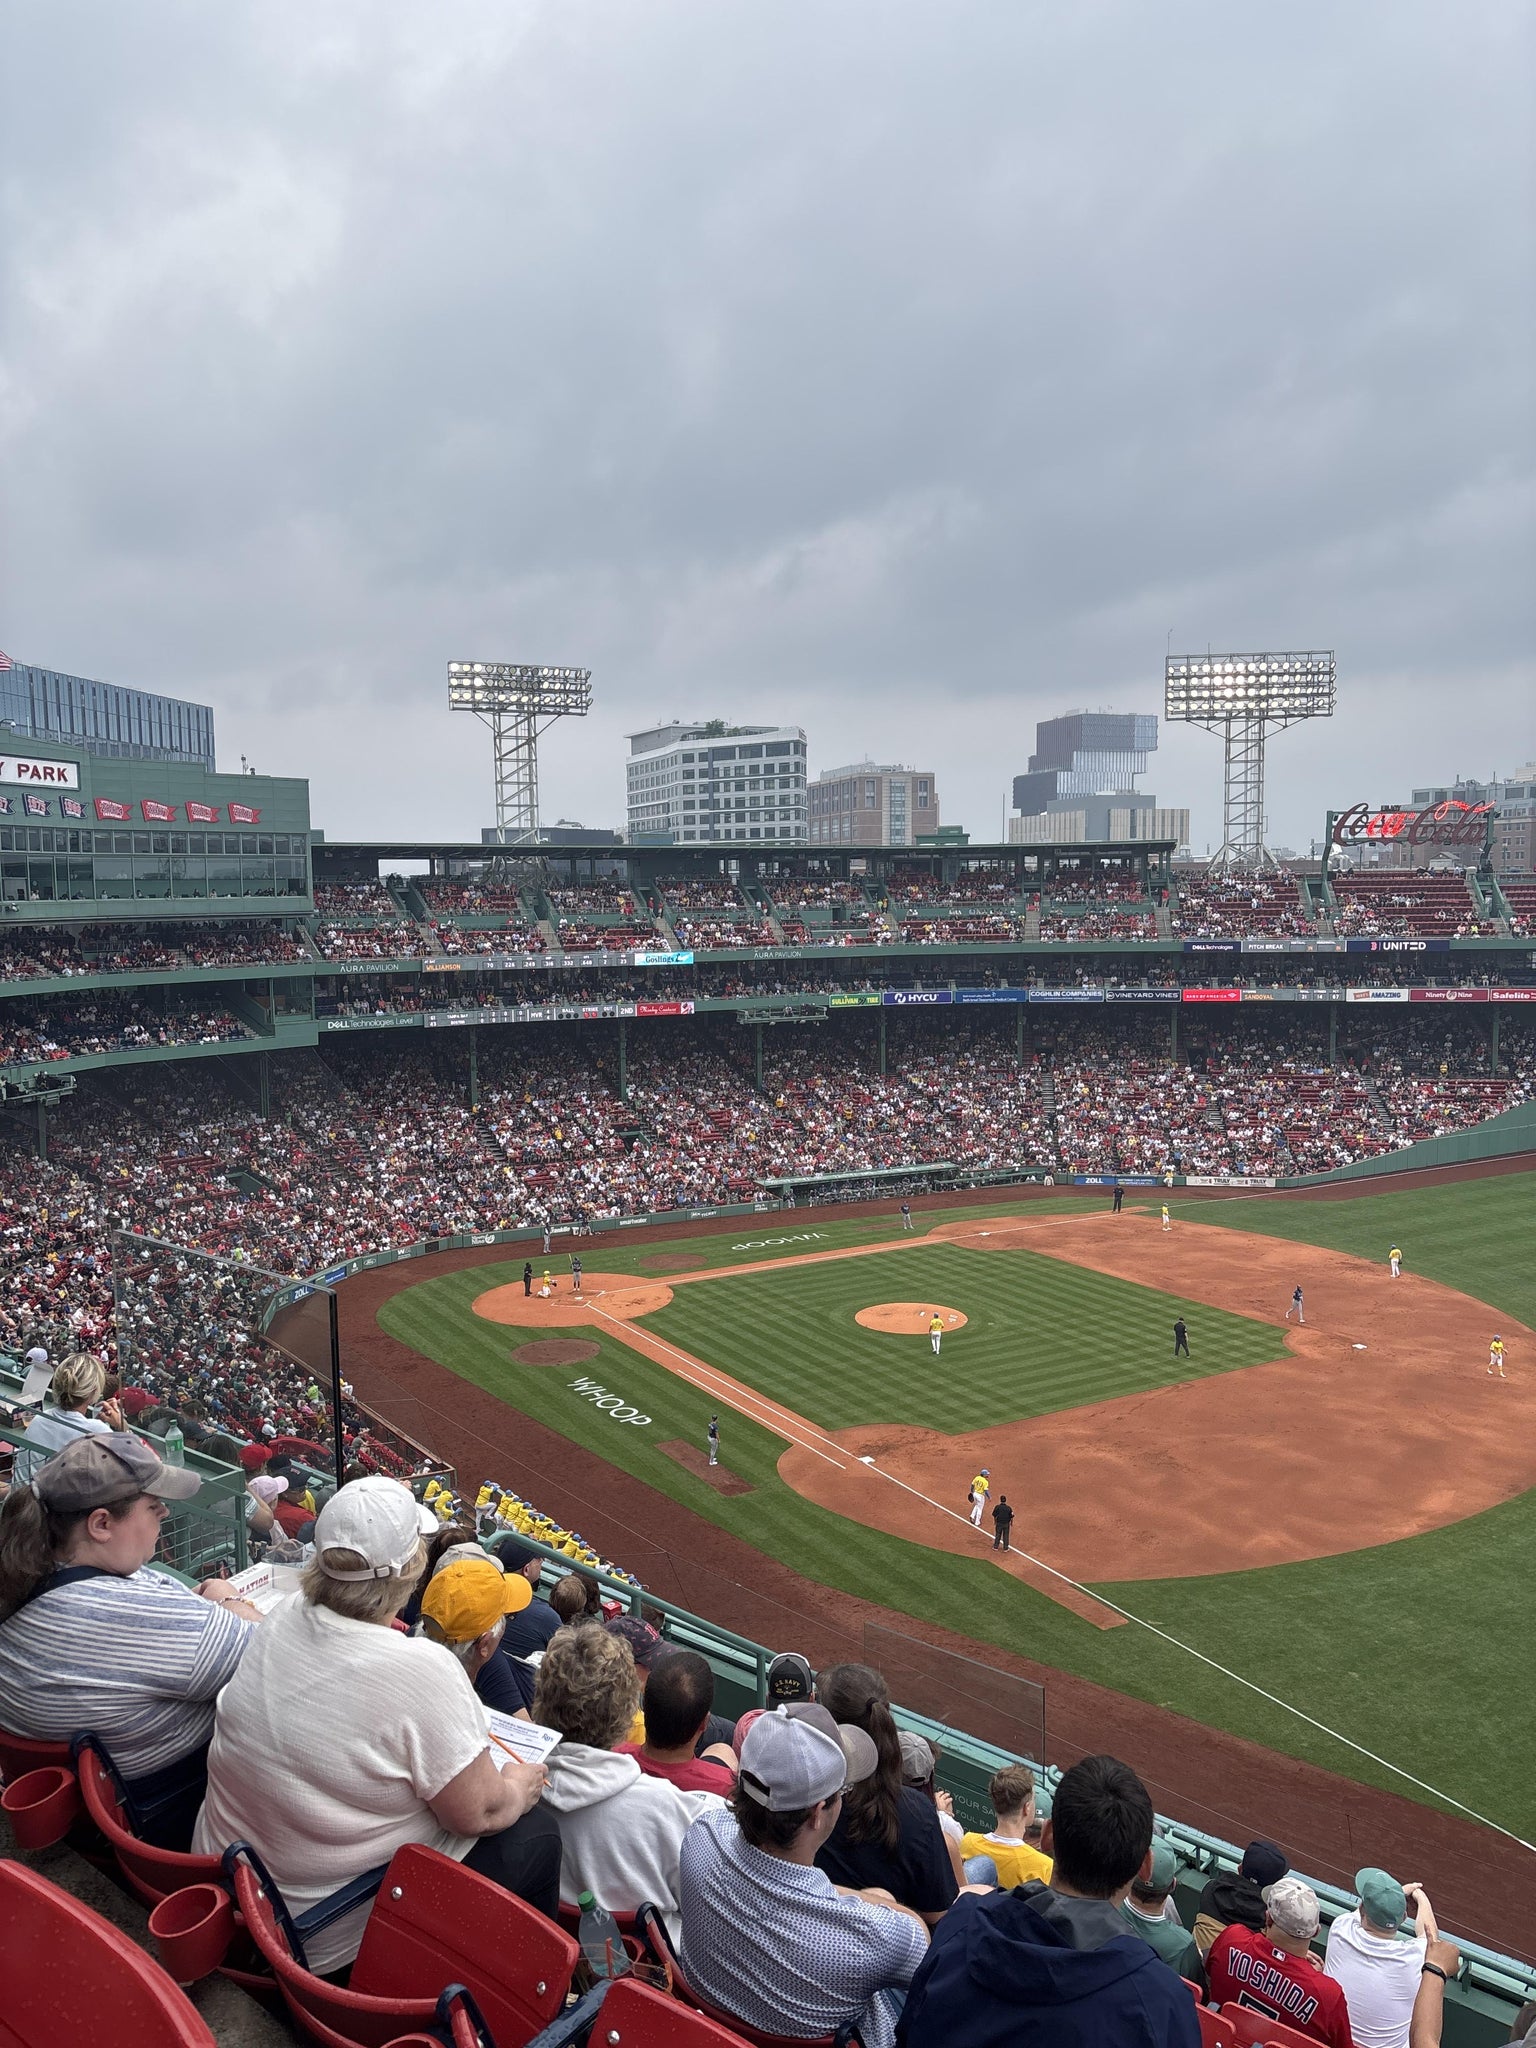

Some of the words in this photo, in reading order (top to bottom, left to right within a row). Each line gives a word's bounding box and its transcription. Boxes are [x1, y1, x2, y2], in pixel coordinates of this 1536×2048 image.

[17, 763, 69, 783] PARK
[1383, 941, 1427, 950] UNITED
[645, 955, 675, 964] Goslings
[366, 963, 399, 972] PAVILION
[908, 993, 937, 1002] HYCU
[1425, 991, 1446, 999] Ninety
[831, 997, 858, 1005] SULLIVAN
[866, 996, 879, 1004] TIRE
[620, 1007, 634, 1015] 2ND
[328, 1021, 350, 1029] DELL
[350, 1018, 394, 1028] Technologies
[395, 1017, 414, 1025] Level
[731, 1232, 831, 1251] WHOOP
[295, 1286, 309, 1299] ZOLL
[566, 1376, 653, 1425] WHOOP
[784, 1679, 801, 1688] NAVY
[953, 1793, 980, 1810] YOUR
[955, 1809, 977, 1824] FOUL
[1227, 1946, 1319, 2025] YOSHIDA
